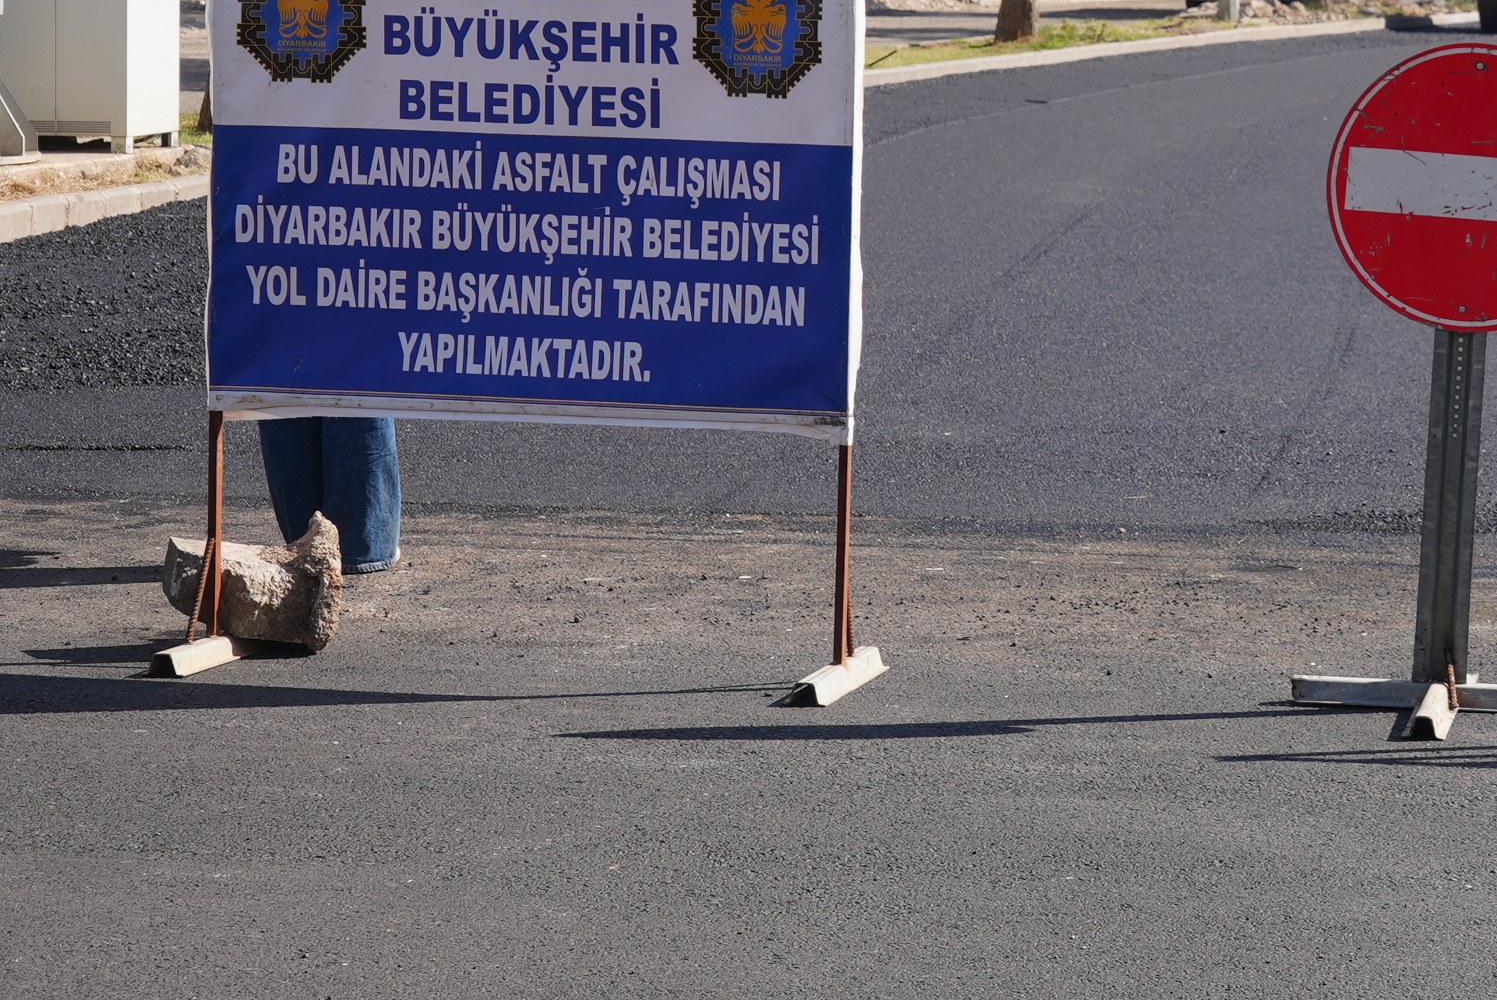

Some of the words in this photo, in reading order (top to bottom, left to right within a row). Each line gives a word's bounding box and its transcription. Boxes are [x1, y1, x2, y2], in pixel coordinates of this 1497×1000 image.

[383, 6, 680, 72] BÜYÜKŞEHİR
[399, 74, 661, 128] BELEDİYESİ
[276, 143, 318, 184] BU
[328, 140, 483, 190] ALANDAKİ
[492, 151, 608, 194] ASFALT
[616, 154, 781, 209] ÇALIŞMASI
[235, 194, 423, 249] DİYARBAKIR
[432, 202, 633, 265] BÜYÜKŞEHİR
[642, 211, 819, 265] BELEDİYESİ
[246, 265, 307, 306] YOL
[316, 258, 407, 310] DAİRE
[417, 267, 603, 323] BAŞKANLIĞI
[612, 278, 806, 327] TARAFINDAN
[397, 331, 650, 382] YAPILMAKTADIR.
